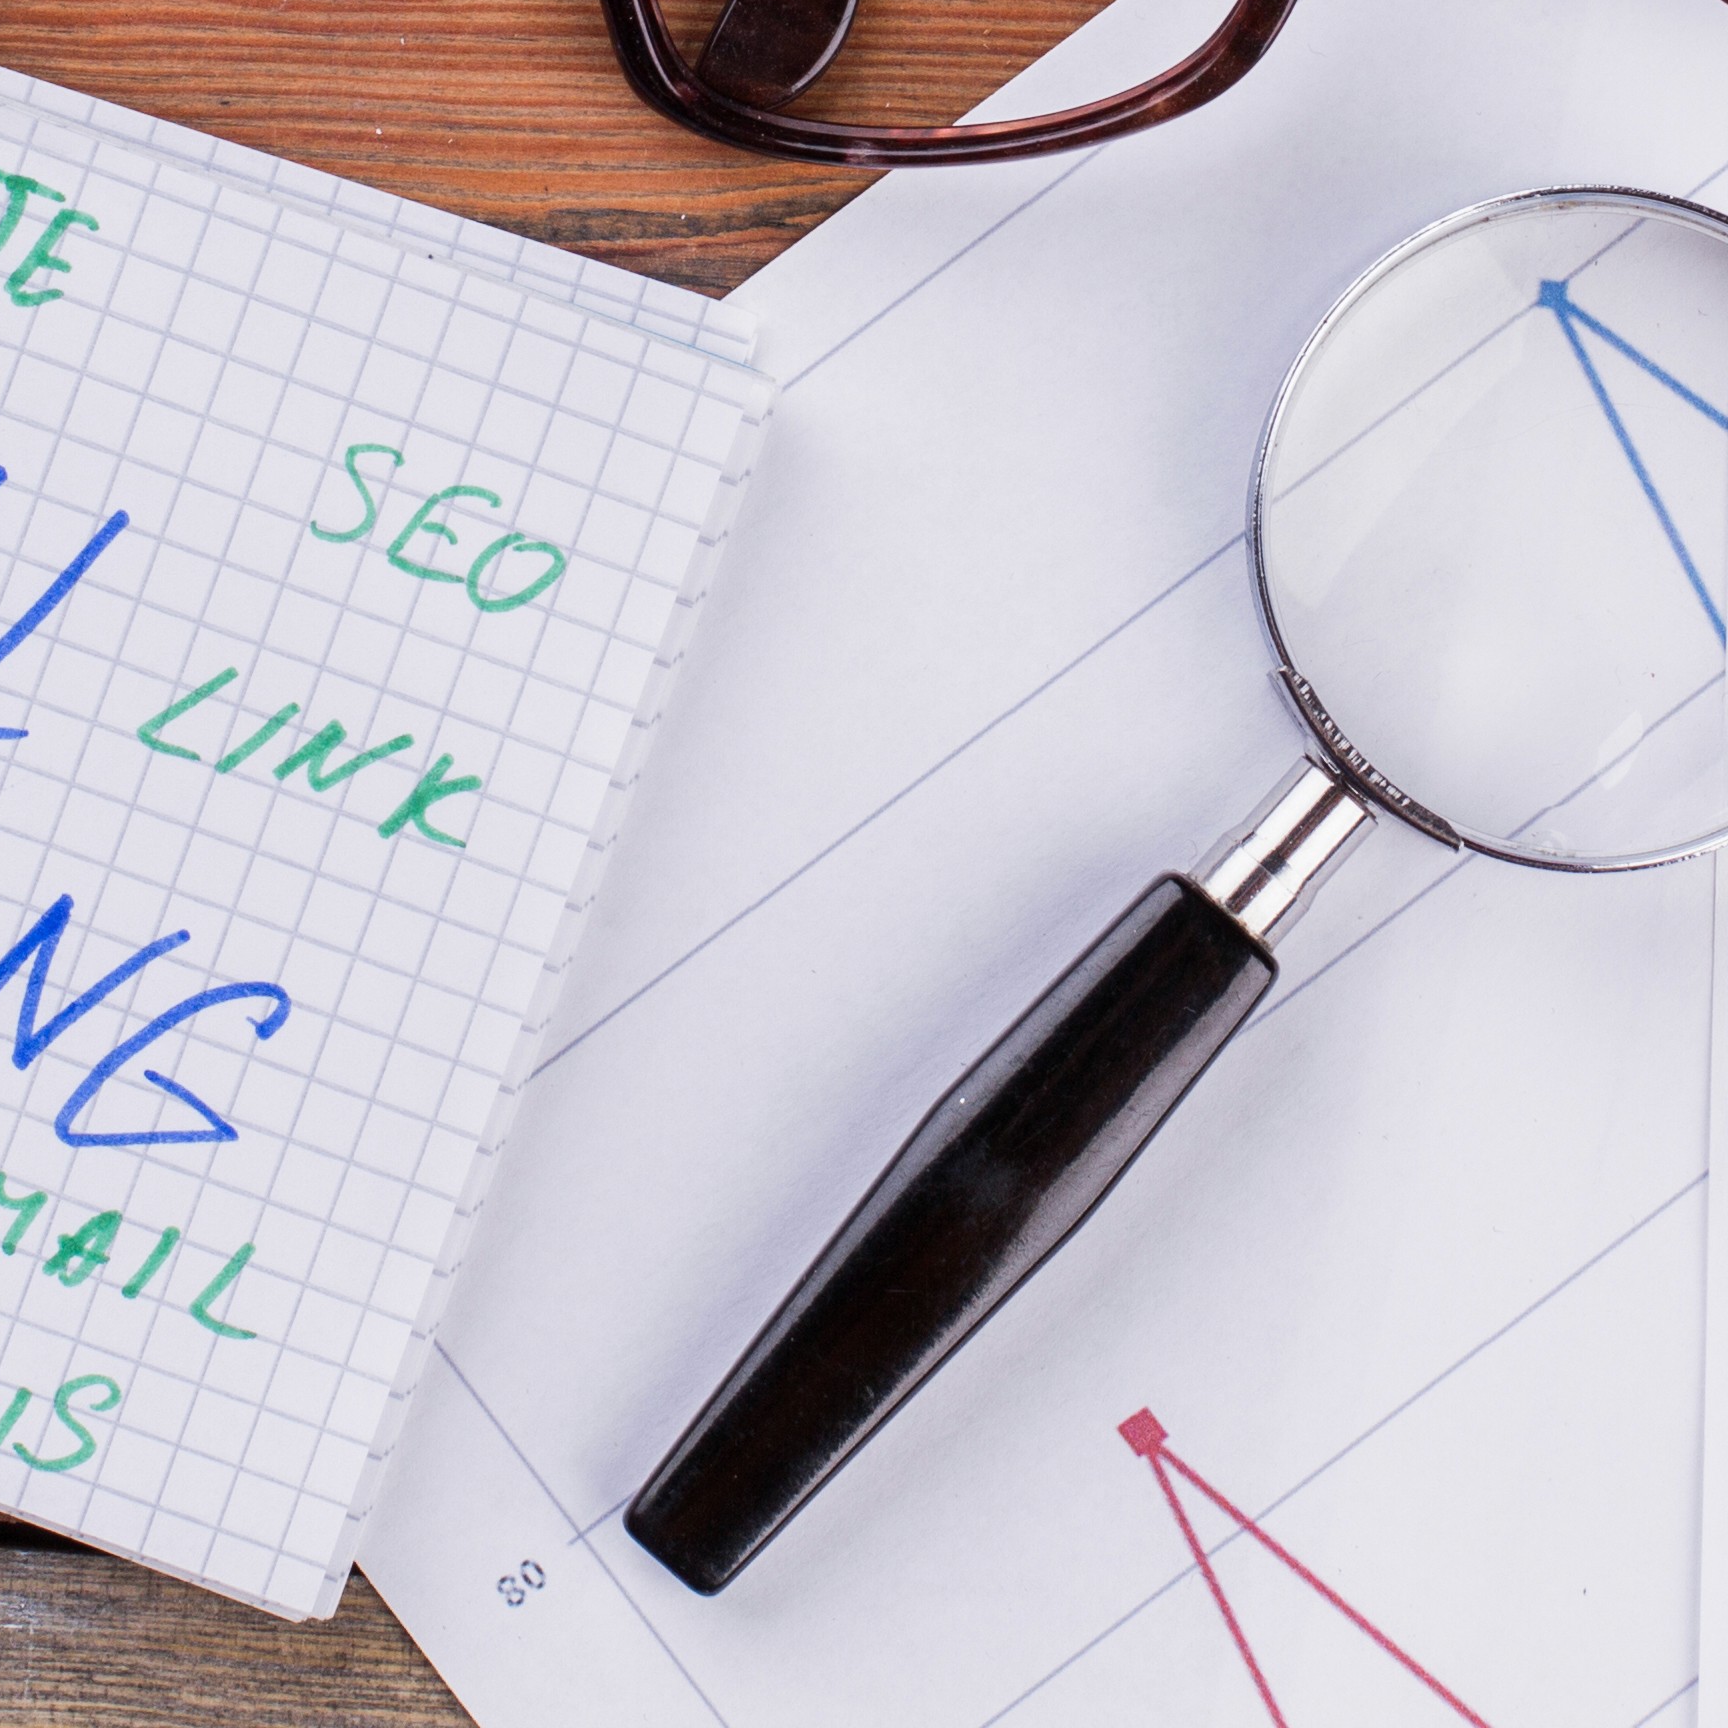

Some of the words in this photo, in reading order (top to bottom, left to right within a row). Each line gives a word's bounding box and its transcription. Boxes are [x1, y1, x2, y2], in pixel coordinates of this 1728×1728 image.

[310, 444, 565, 613] SEO
[137, 668, 481, 848] LINK
[497, 1559, 545, 1607] 80
